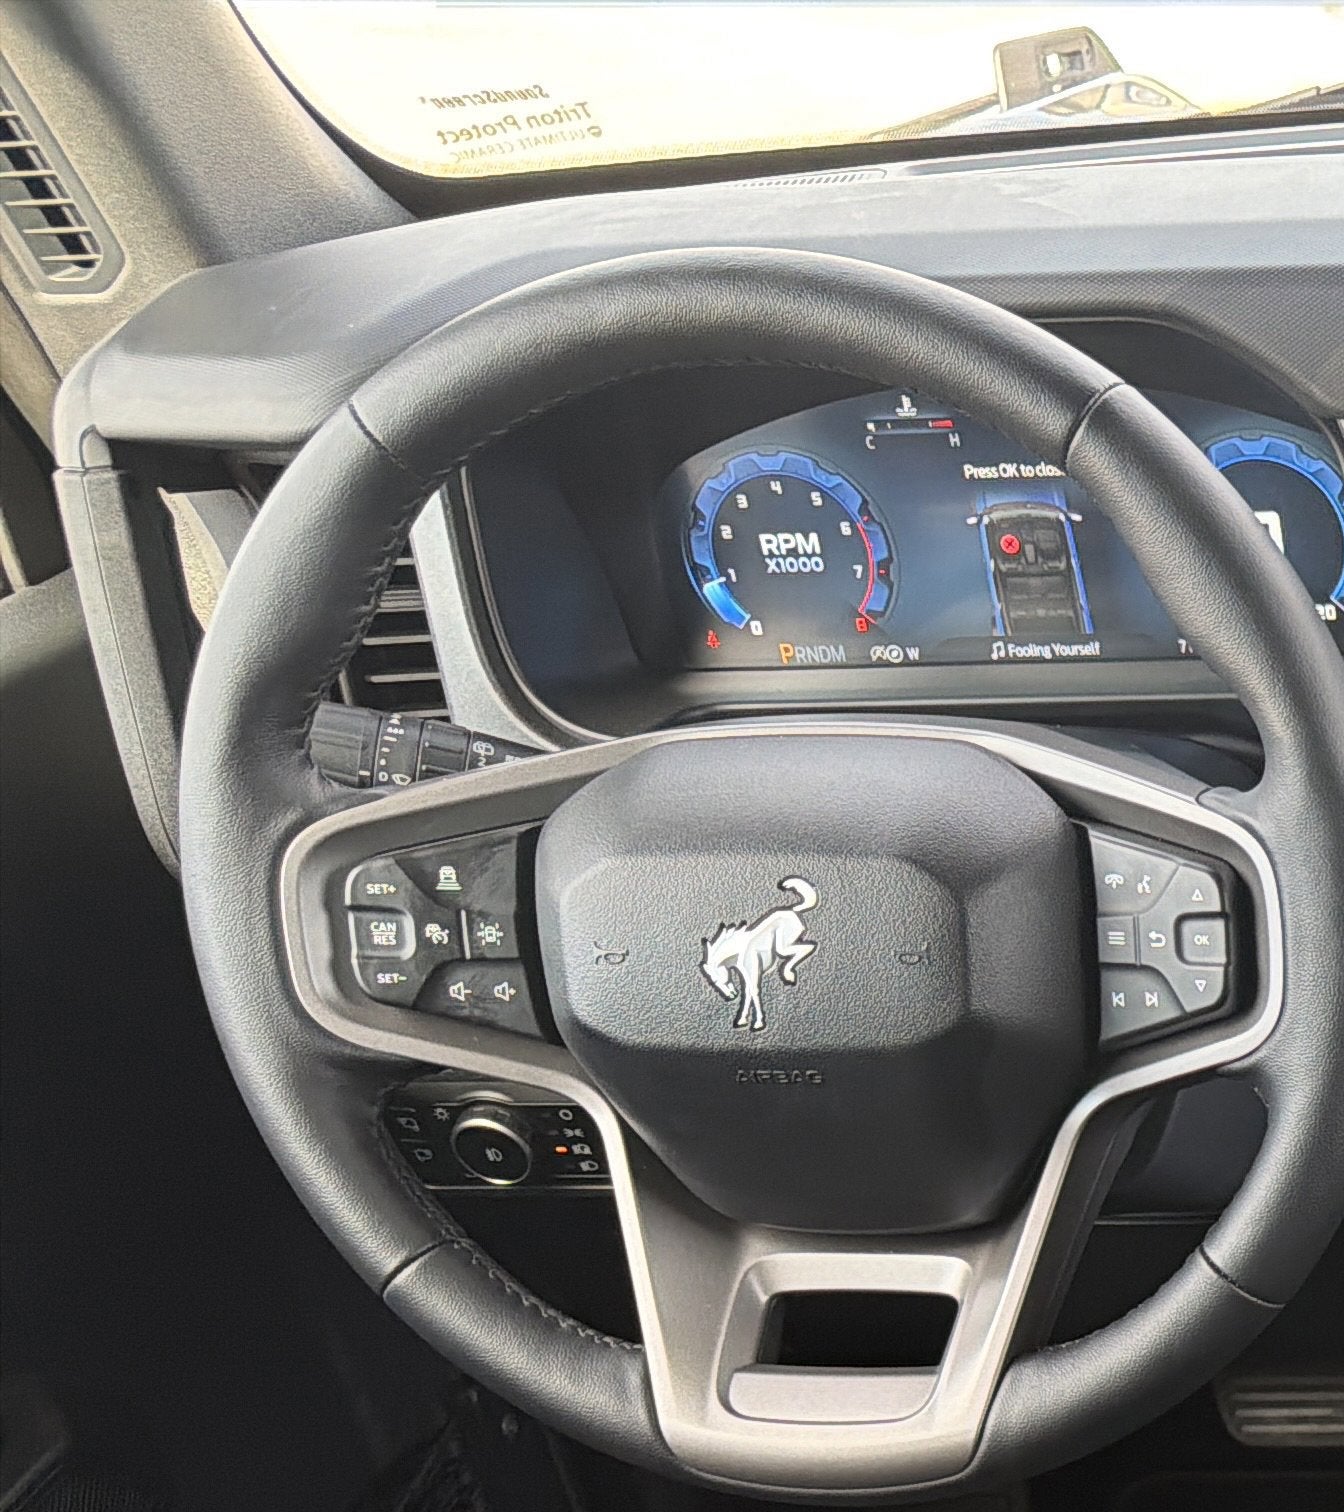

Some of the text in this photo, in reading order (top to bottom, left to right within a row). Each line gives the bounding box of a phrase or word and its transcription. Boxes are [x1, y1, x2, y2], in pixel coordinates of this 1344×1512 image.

[949, 433, 961, 448] H
[963, 461, 1066, 480] Press OK to clos
[770, 481, 782, 495] 4
[759, 532, 822, 555] RPM
[765, 556, 824, 573] X1000
[1007, 641, 1100, 660] Fooling Yourself
[370, 921, 397, 934] CAN
[373, 934, 397, 946] RES
[1194, 934, 1210, 946] OK
